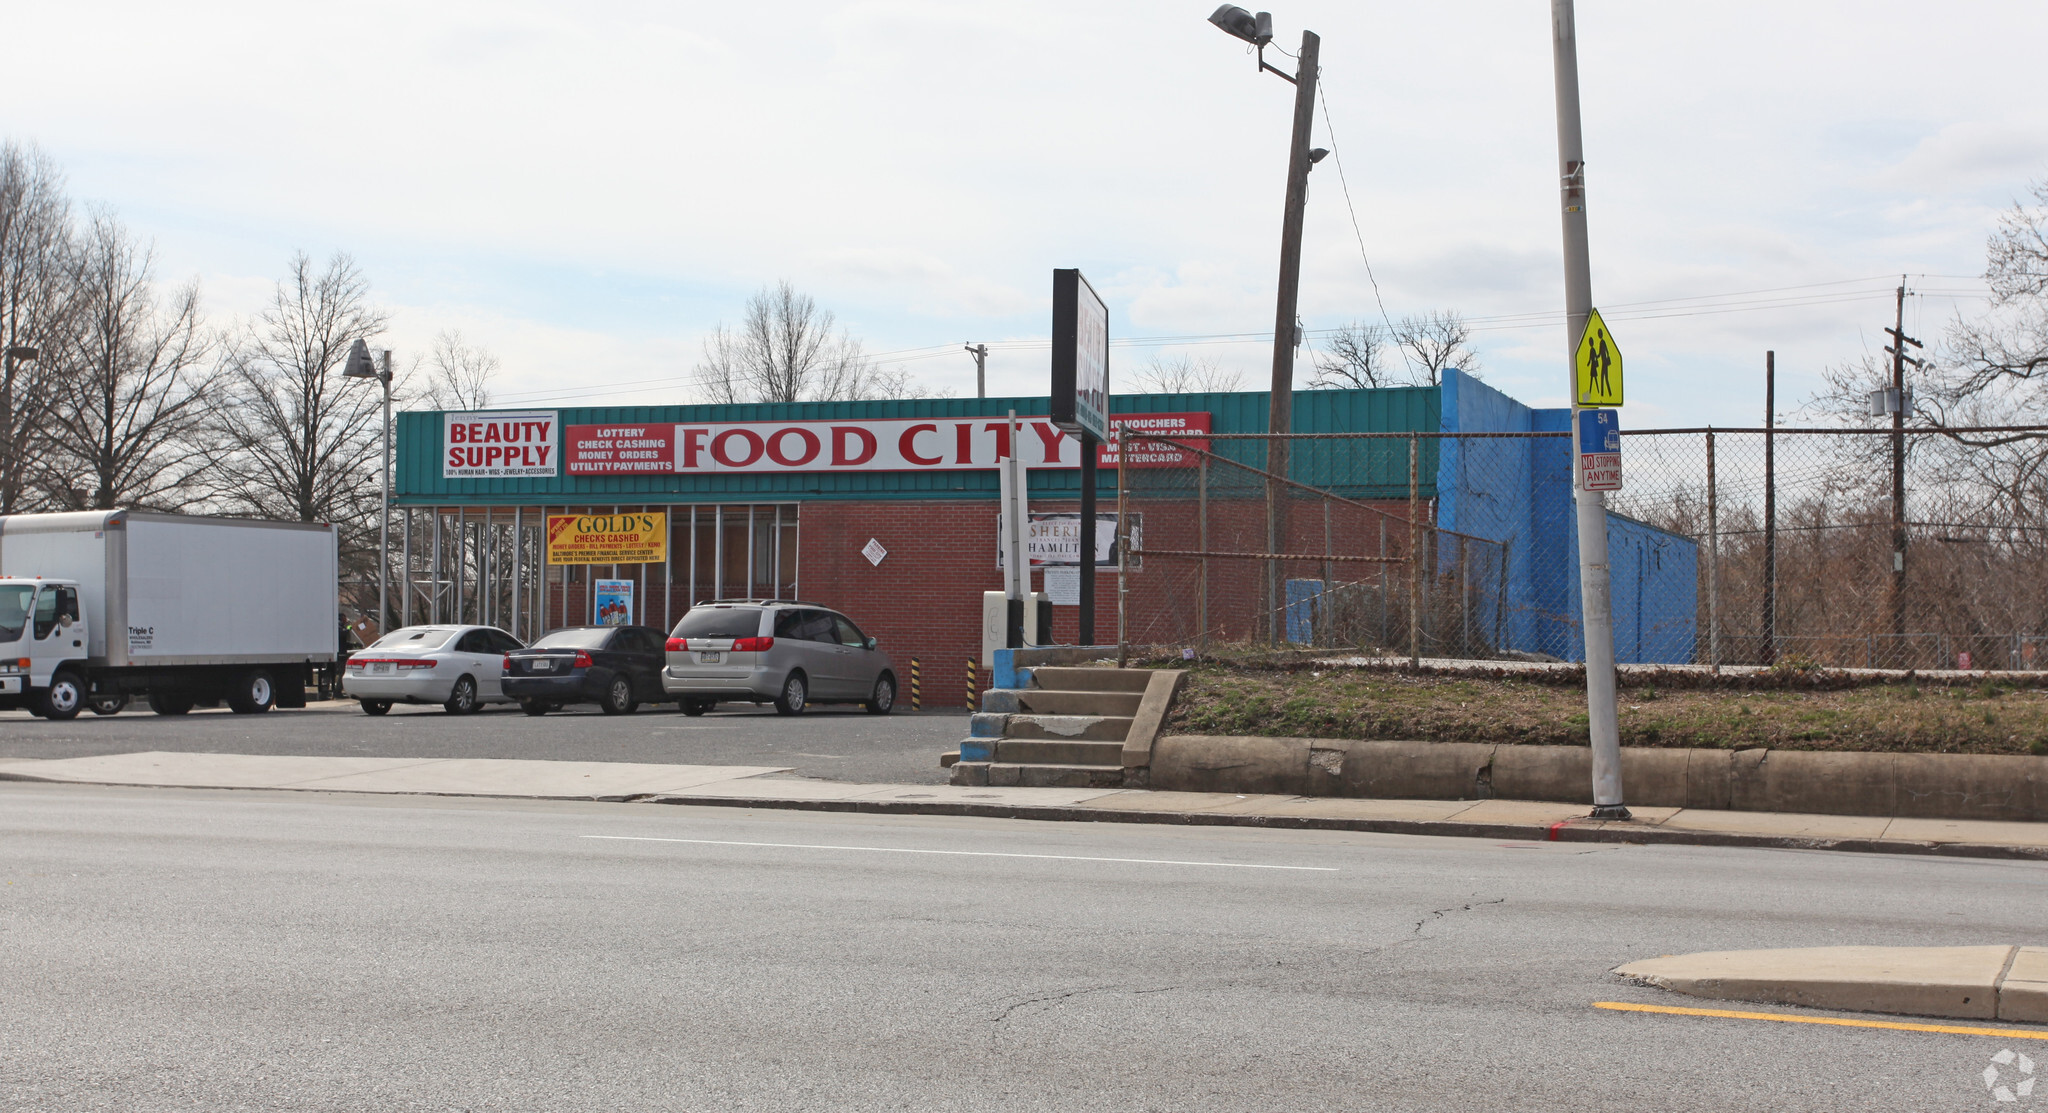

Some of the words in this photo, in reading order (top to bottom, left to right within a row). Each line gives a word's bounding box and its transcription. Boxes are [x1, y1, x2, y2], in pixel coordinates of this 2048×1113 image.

[1124, 418, 1186, 429] VOUCHERS
[1597, 412, 1608, 424] 54
[451, 421, 551, 444] BEAUTY
[597, 428, 646, 438] LOTTERY
[577, 440, 614, 449] CHECK
[616, 439, 666, 448] CASHING
[682, 426, 878, 468] FOOD
[898, 422, 1067, 466] CITY
[448, 445, 551, 468] SUPPLY
[578, 451, 614, 459] MONEY
[619, 450, 659, 459] ORDERS
[1101, 453, 1183, 463] MATERCARD
[570, 462, 612, 471] UTILITY
[613, 461, 673, 471] PAYMENTS
[1582, 456, 1594, 469] NO
[1596, 455, 1620, 468] STOPPING
[1587, 470, 1620, 481] ANYTIME
[577, 515, 653, 533] GOLD'S
[1030, 525, 1097, 537] SHERI
[574, 535, 606, 543] CHECKS
[607, 533, 640, 542] CASHED
[1028, 543, 1099, 553] HAMILTN
[129, 627, 147, 635] Triple
